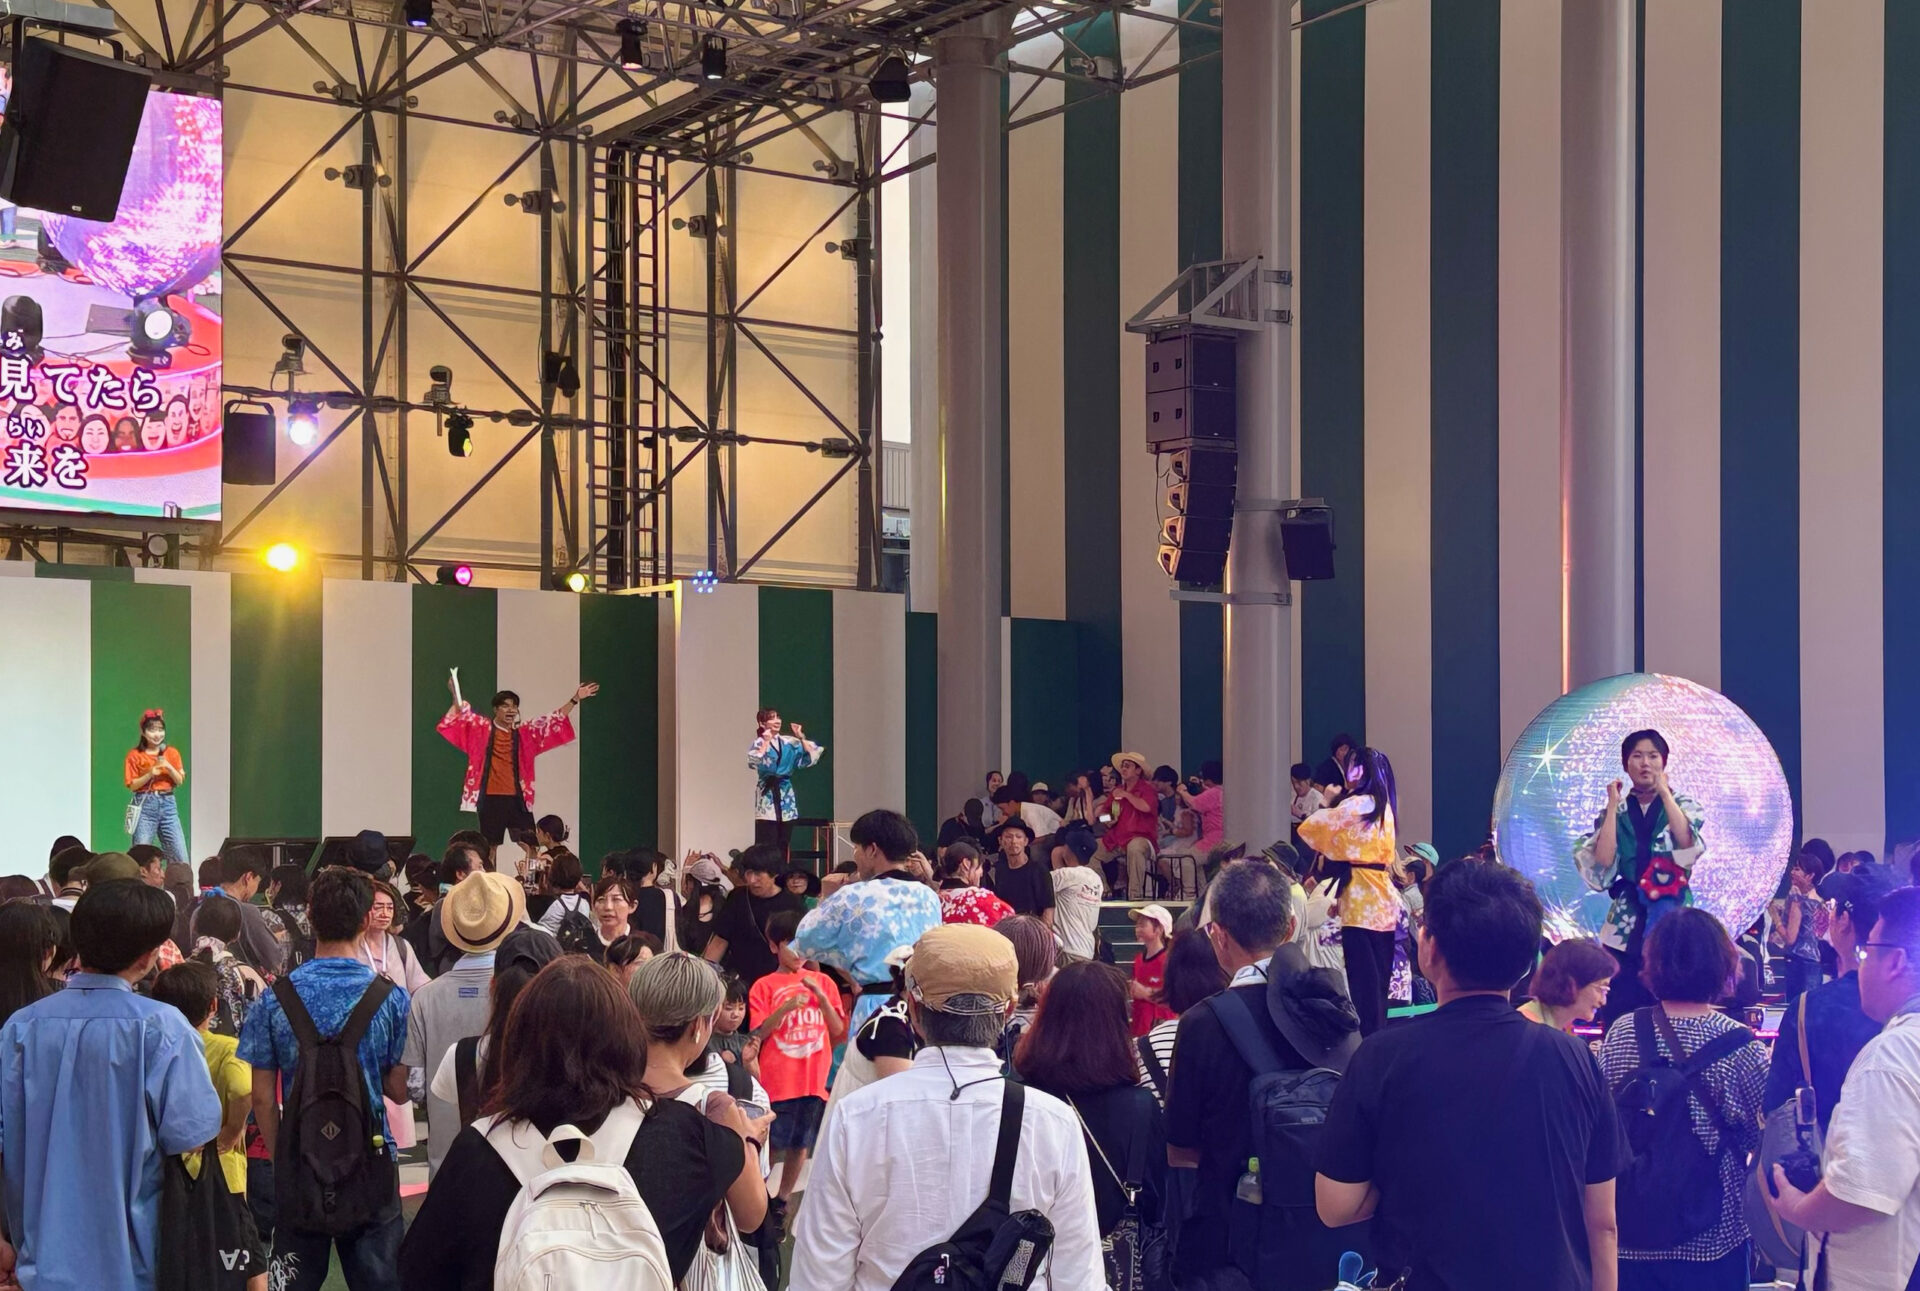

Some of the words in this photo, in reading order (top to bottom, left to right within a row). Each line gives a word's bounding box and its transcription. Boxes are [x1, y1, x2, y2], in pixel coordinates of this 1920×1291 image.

[0, 357, 161, 410] 見てたら
[8, 418, 45, 437] らい
[6, 442, 86, 486] 来を
